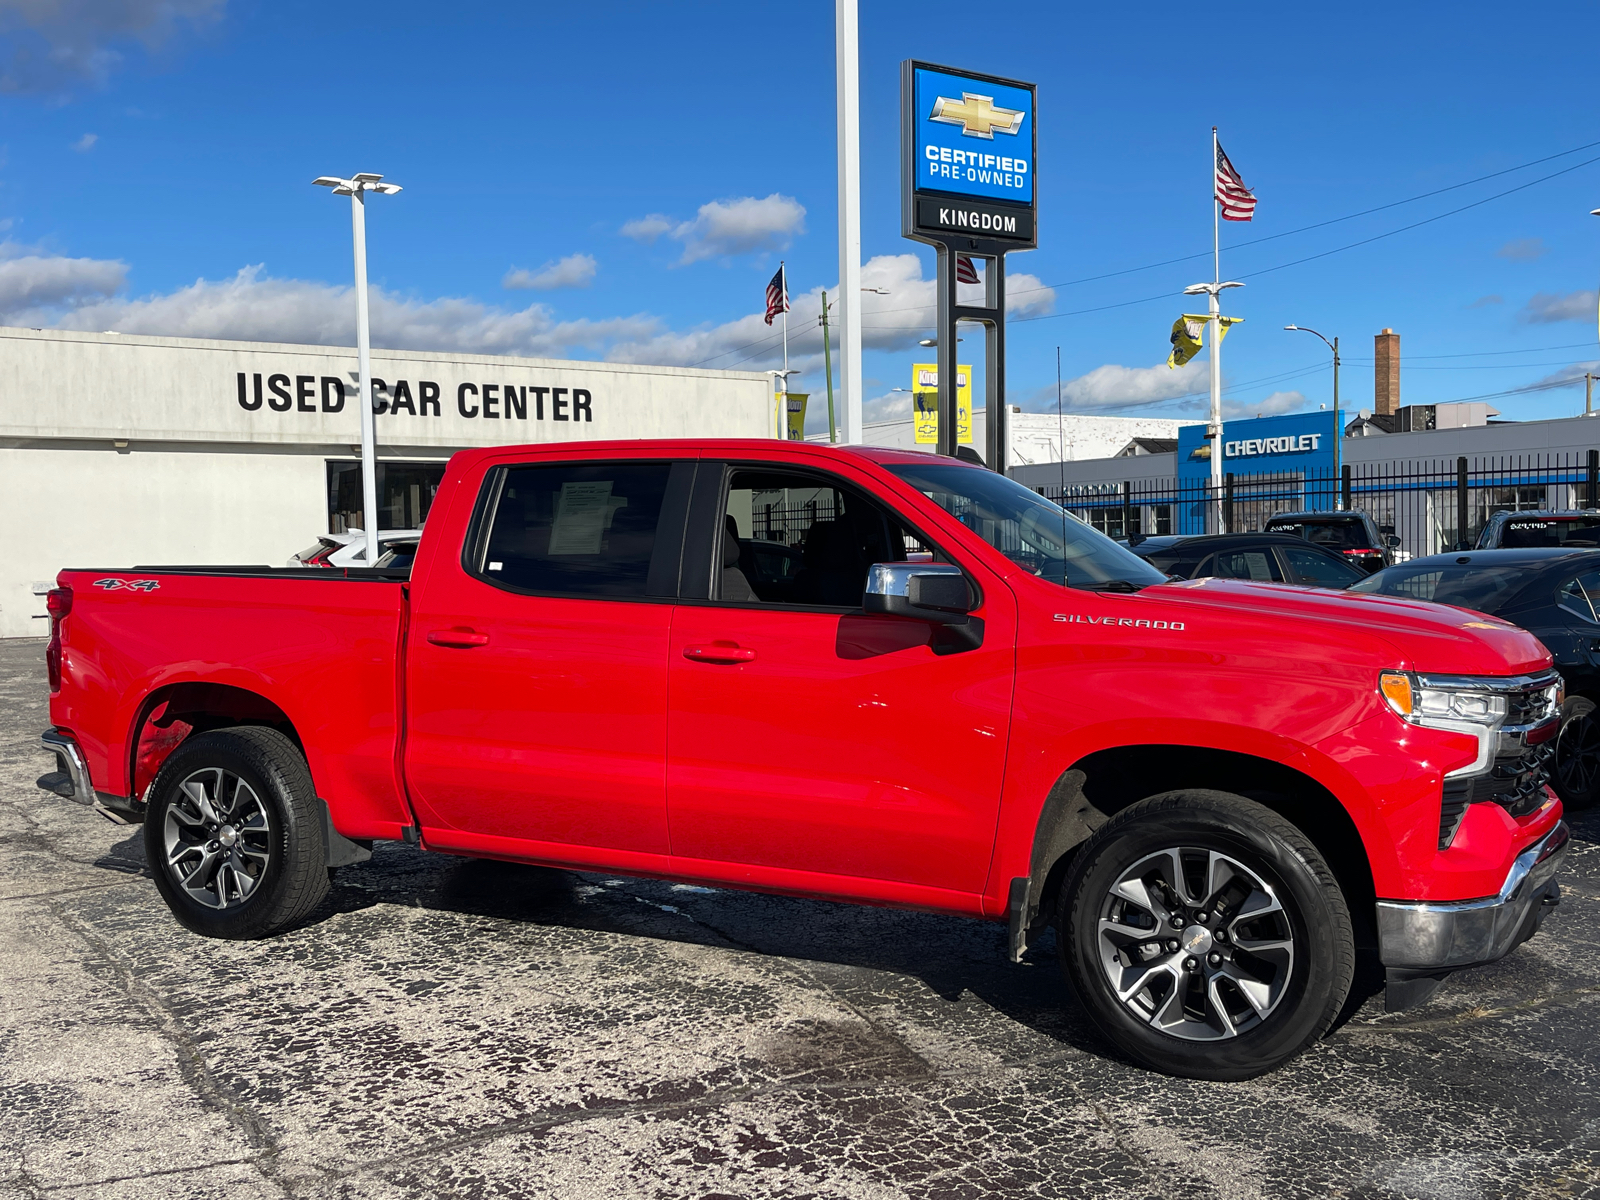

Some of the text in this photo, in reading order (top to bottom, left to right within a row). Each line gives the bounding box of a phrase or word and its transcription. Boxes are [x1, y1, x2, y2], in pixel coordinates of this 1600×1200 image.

[925, 145, 1028, 173] CERTIFIED
[930, 162, 1024, 188] PRE-OWNED
[939, 208, 1016, 233] KINGDOM
[237, 372, 593, 422] USED CAR CENTER
[1226, 434, 1321, 457] CHEVROLET
[1053, 613, 1185, 631] SILVERADO
